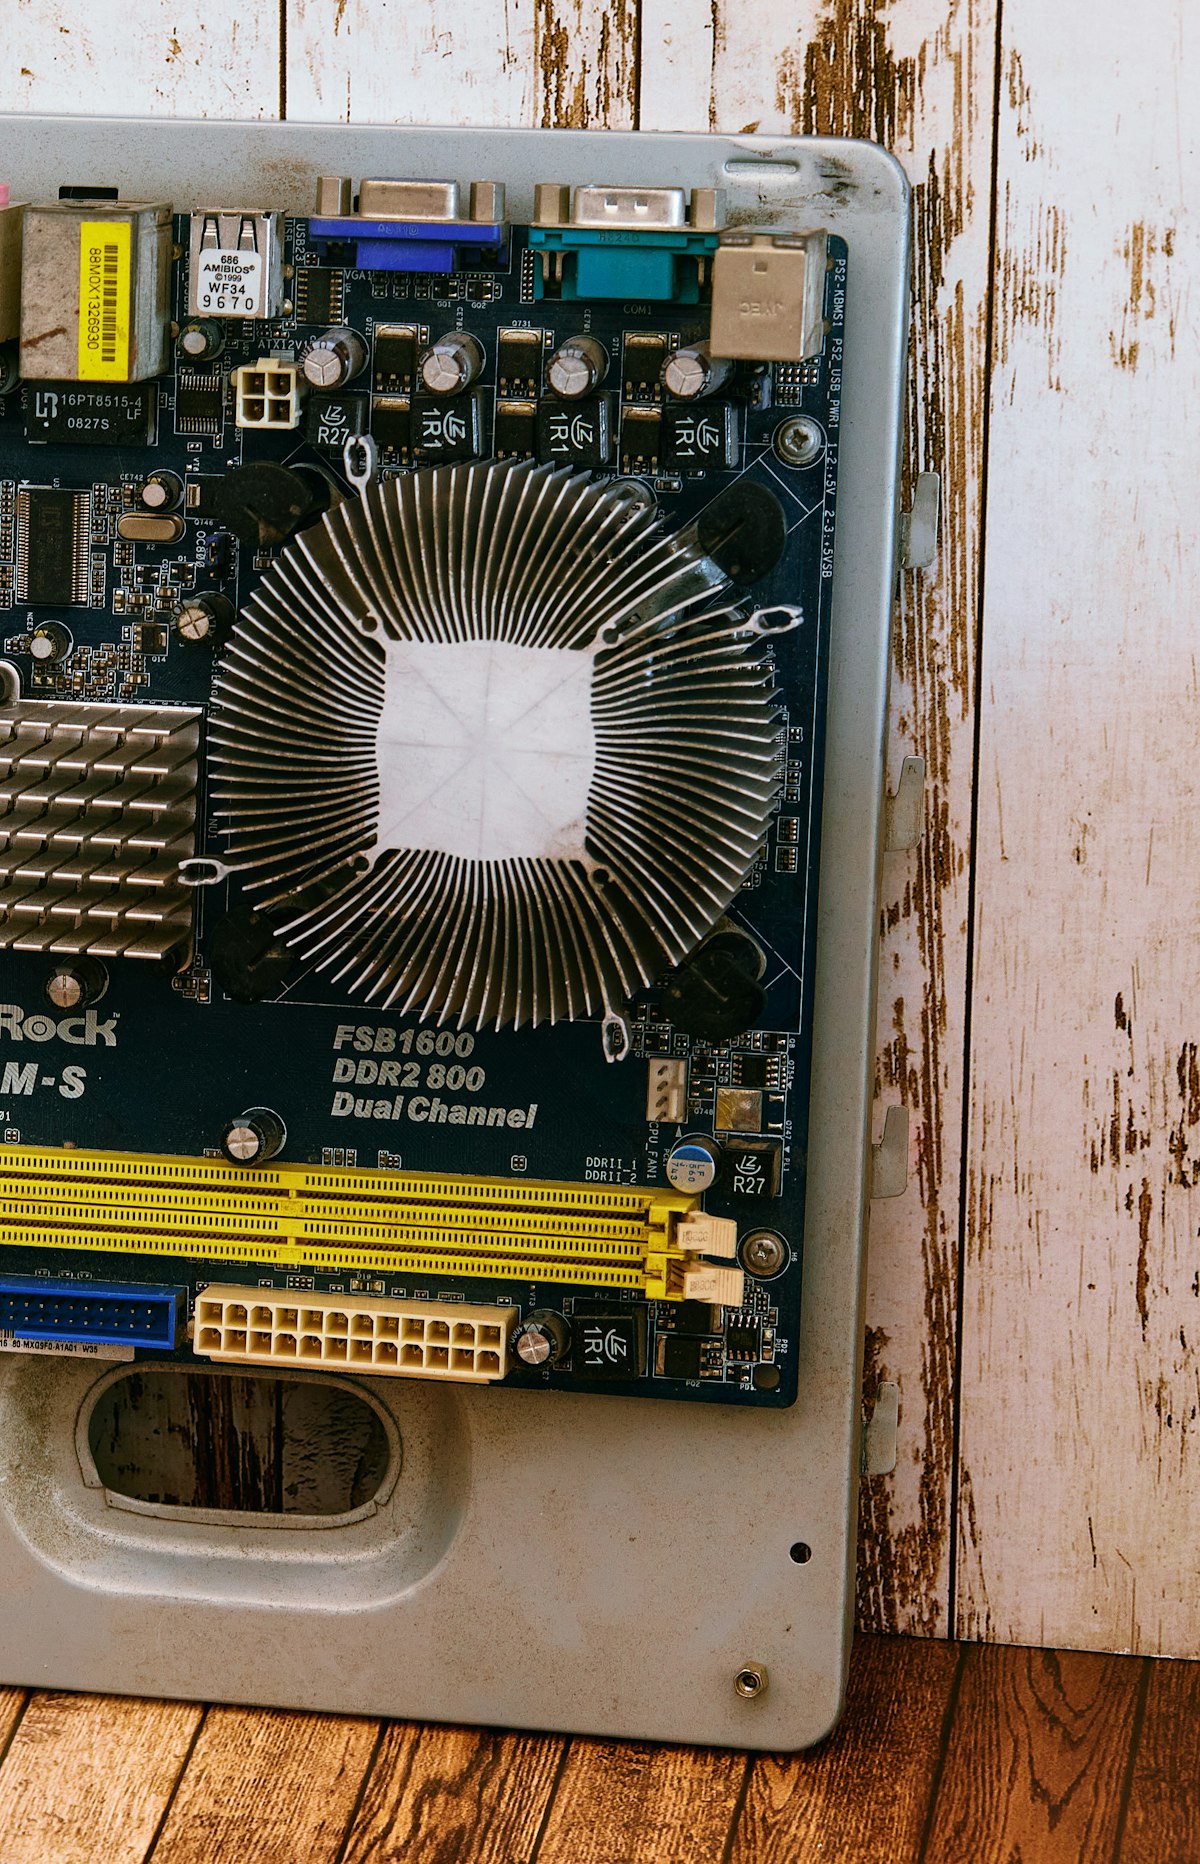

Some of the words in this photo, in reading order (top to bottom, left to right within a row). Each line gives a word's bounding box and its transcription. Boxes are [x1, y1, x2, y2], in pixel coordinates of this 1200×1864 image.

[221, 255, 239, 264] 686
[295, 224, 306, 261] USB23
[209, 282, 246, 295] WF34
[344, 269, 371, 281] VGA1
[87, 247, 102, 350] 88M0X1326930
[623, 304, 652, 315] COM1
[834, 258, 846, 335] PS2-KBMS1
[828, 337, 843, 428] PS2_USB_PWR1
[61, 394, 142, 408] 16PT8515-4
[127, 408, 141, 420] LF
[67, 416, 109, 430] 0827S
[318, 427, 350, 445] R27
[422, 408, 442, 449] 1R1
[548, 412, 569, 454] 1R1
[675, 415, 694, 457] 1R1
[333, 1024, 475, 1058] FSB1600
[332, 1057, 420, 1088] DDR2
[426, 1064, 486, 1092] 800
[331, 1091, 404, 1120] Dual
[408, 1097, 538, 1129] Channel
[586, 1157, 637, 1170] DDRII_1
[645, 1121, 659, 1179] CPU_FAN1
[585, 1170, 637, 1184] DDRII_2
[733, 1176, 766, 1194] R27
[583, 1326, 603, 1365] 1R1
